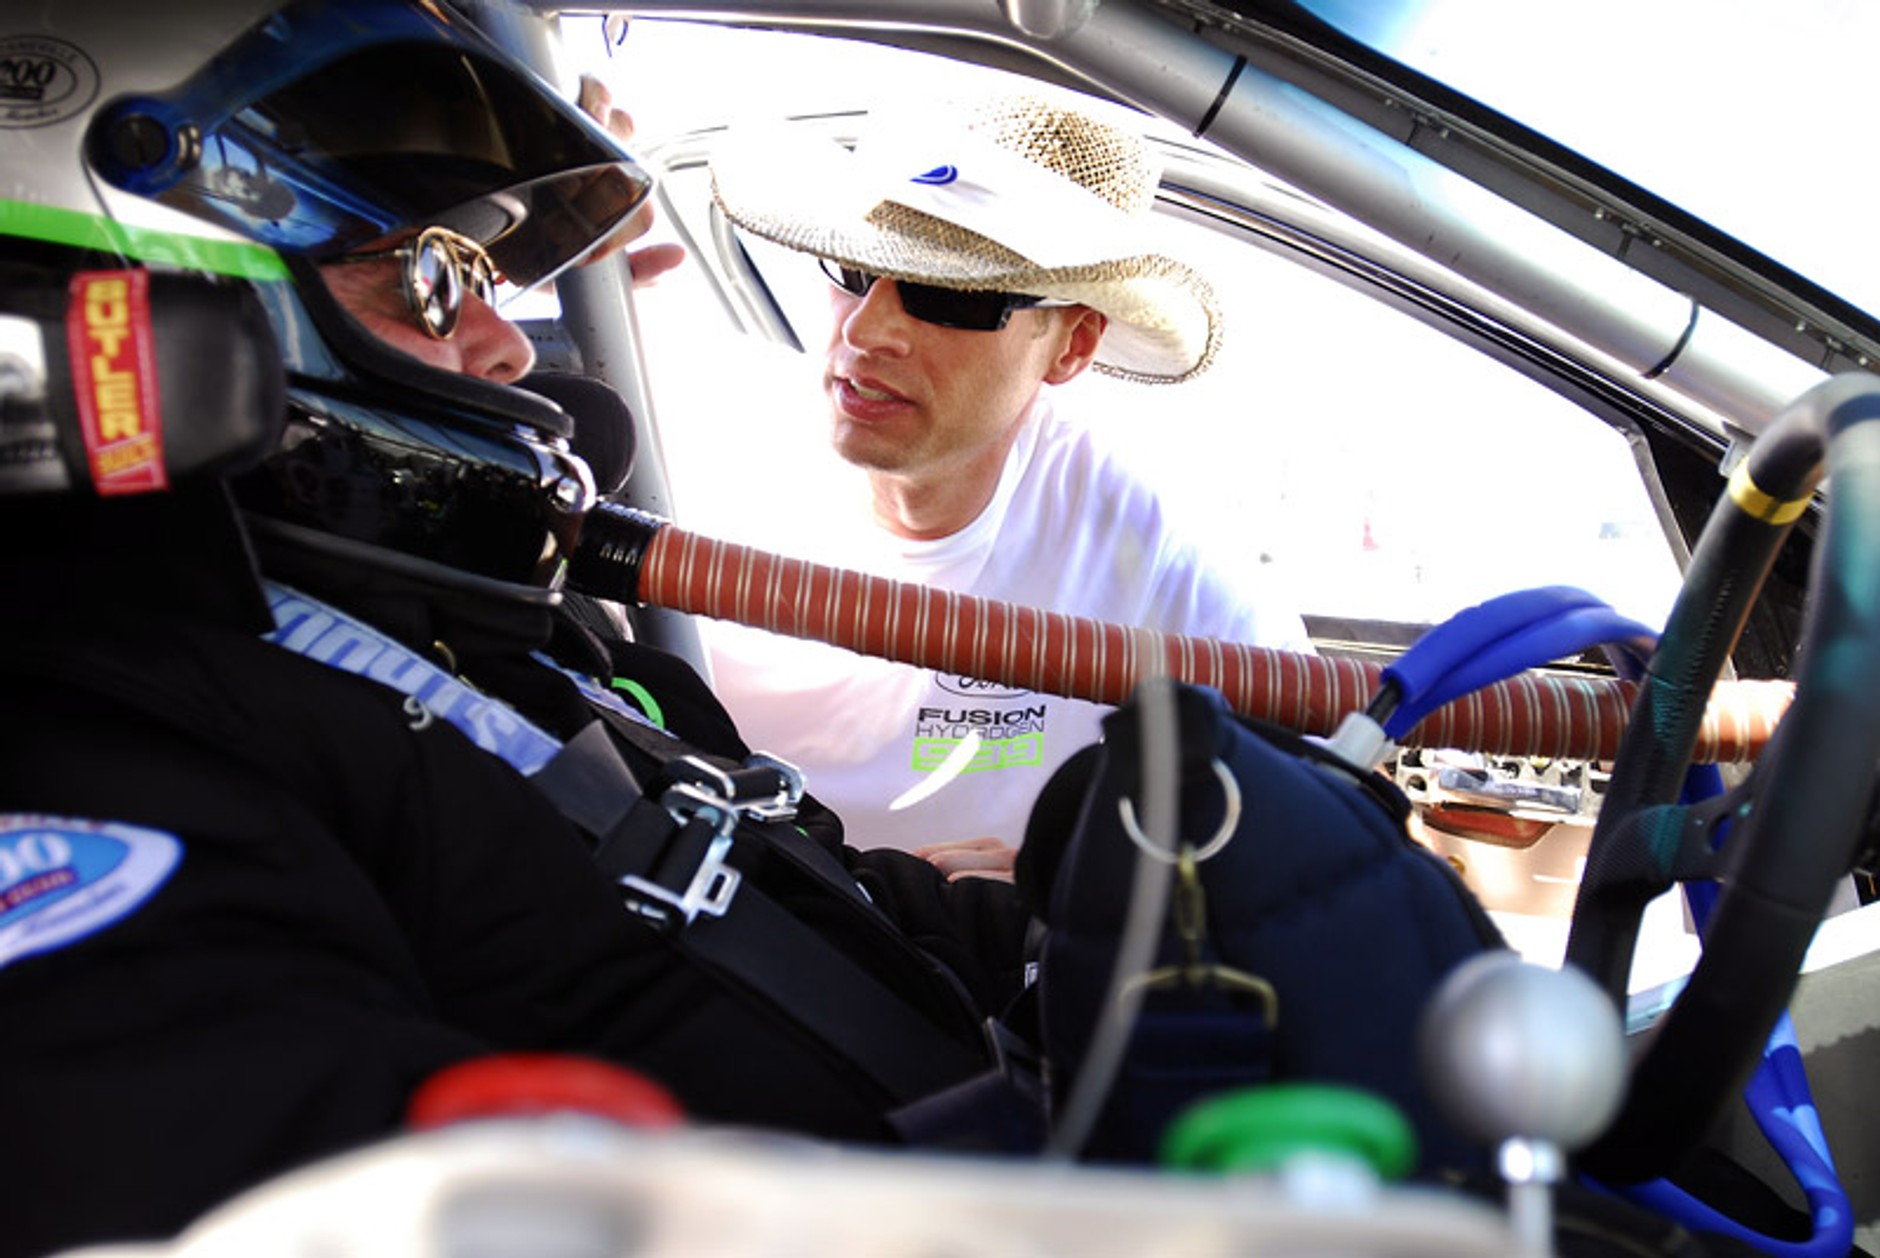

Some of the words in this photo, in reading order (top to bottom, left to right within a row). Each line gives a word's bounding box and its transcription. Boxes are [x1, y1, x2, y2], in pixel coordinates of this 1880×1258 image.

[84, 279, 141, 440] BUTLER
[918, 704, 1047, 726] FUSION
[914, 720, 1045, 740] HYDROGEN
